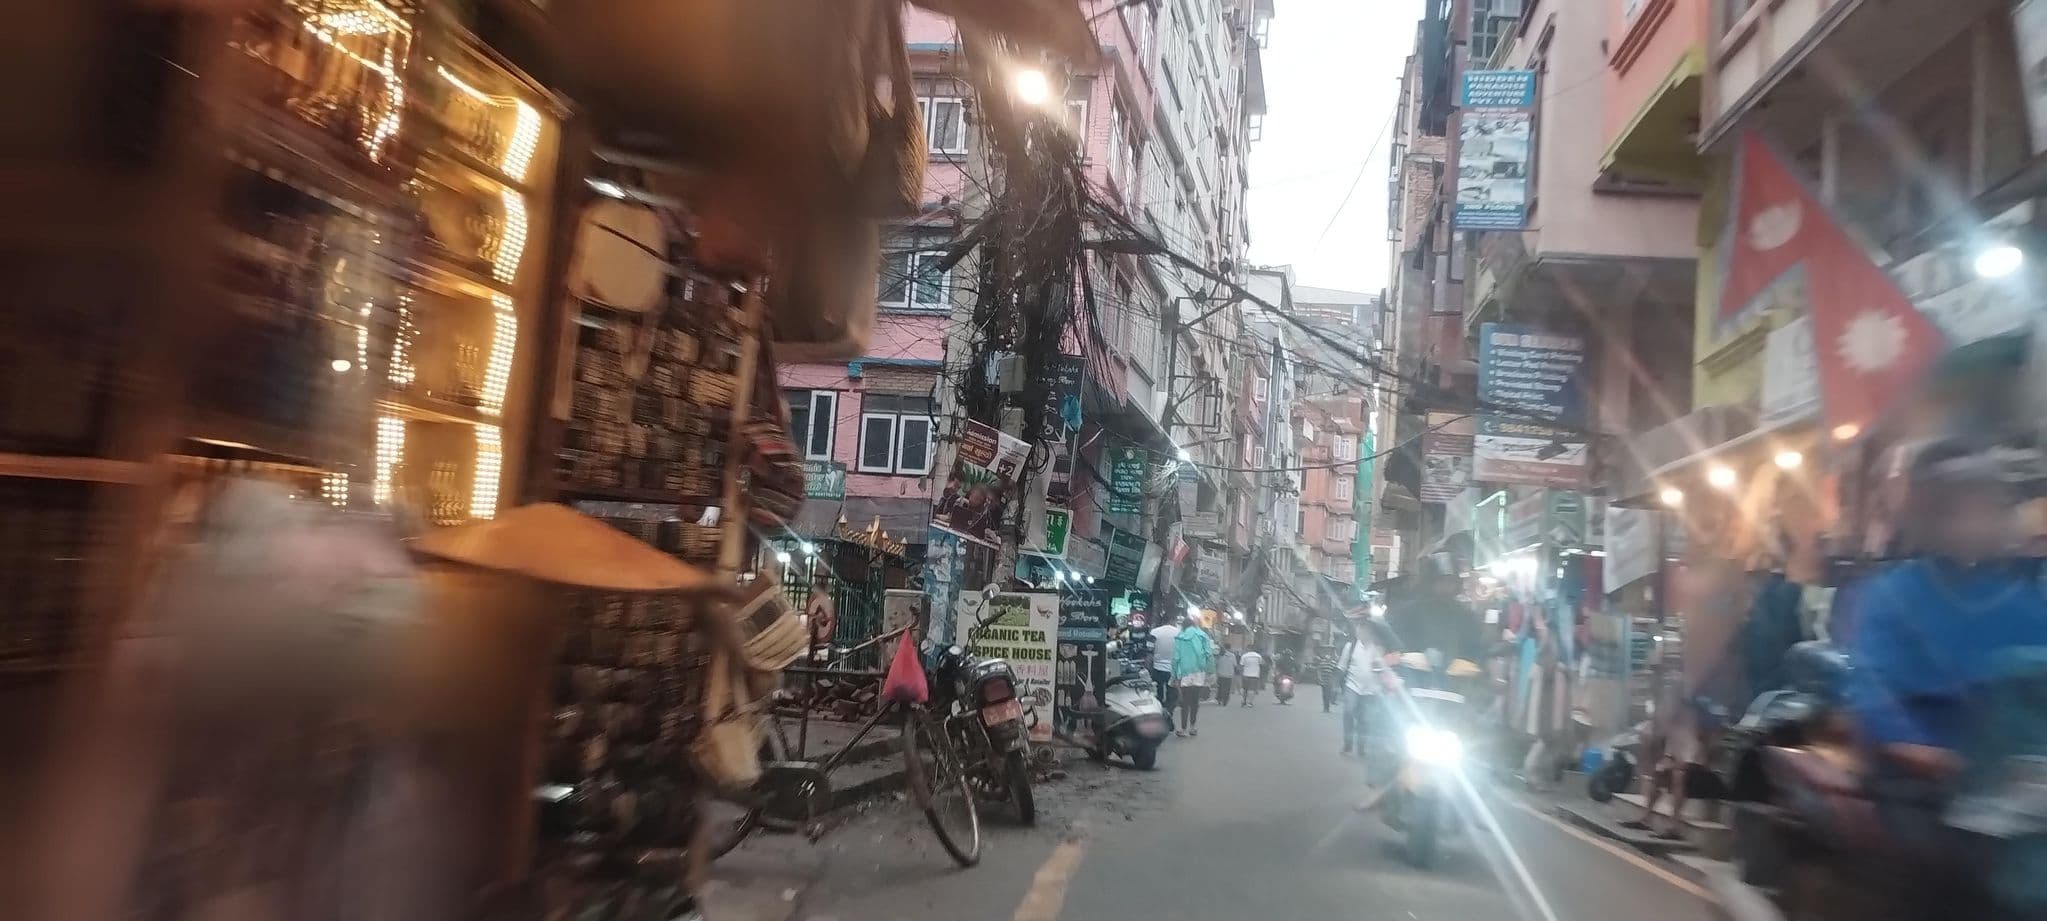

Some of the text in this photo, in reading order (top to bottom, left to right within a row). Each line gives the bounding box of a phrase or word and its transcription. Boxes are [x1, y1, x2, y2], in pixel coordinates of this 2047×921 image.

[1467, 90, 1526, 98] ADVENTURE
[998, 463, 1014, 477] +2
[1022, 630, 1046, 642] TEA
[975, 646, 1052, 660] SPICE HOUSE
